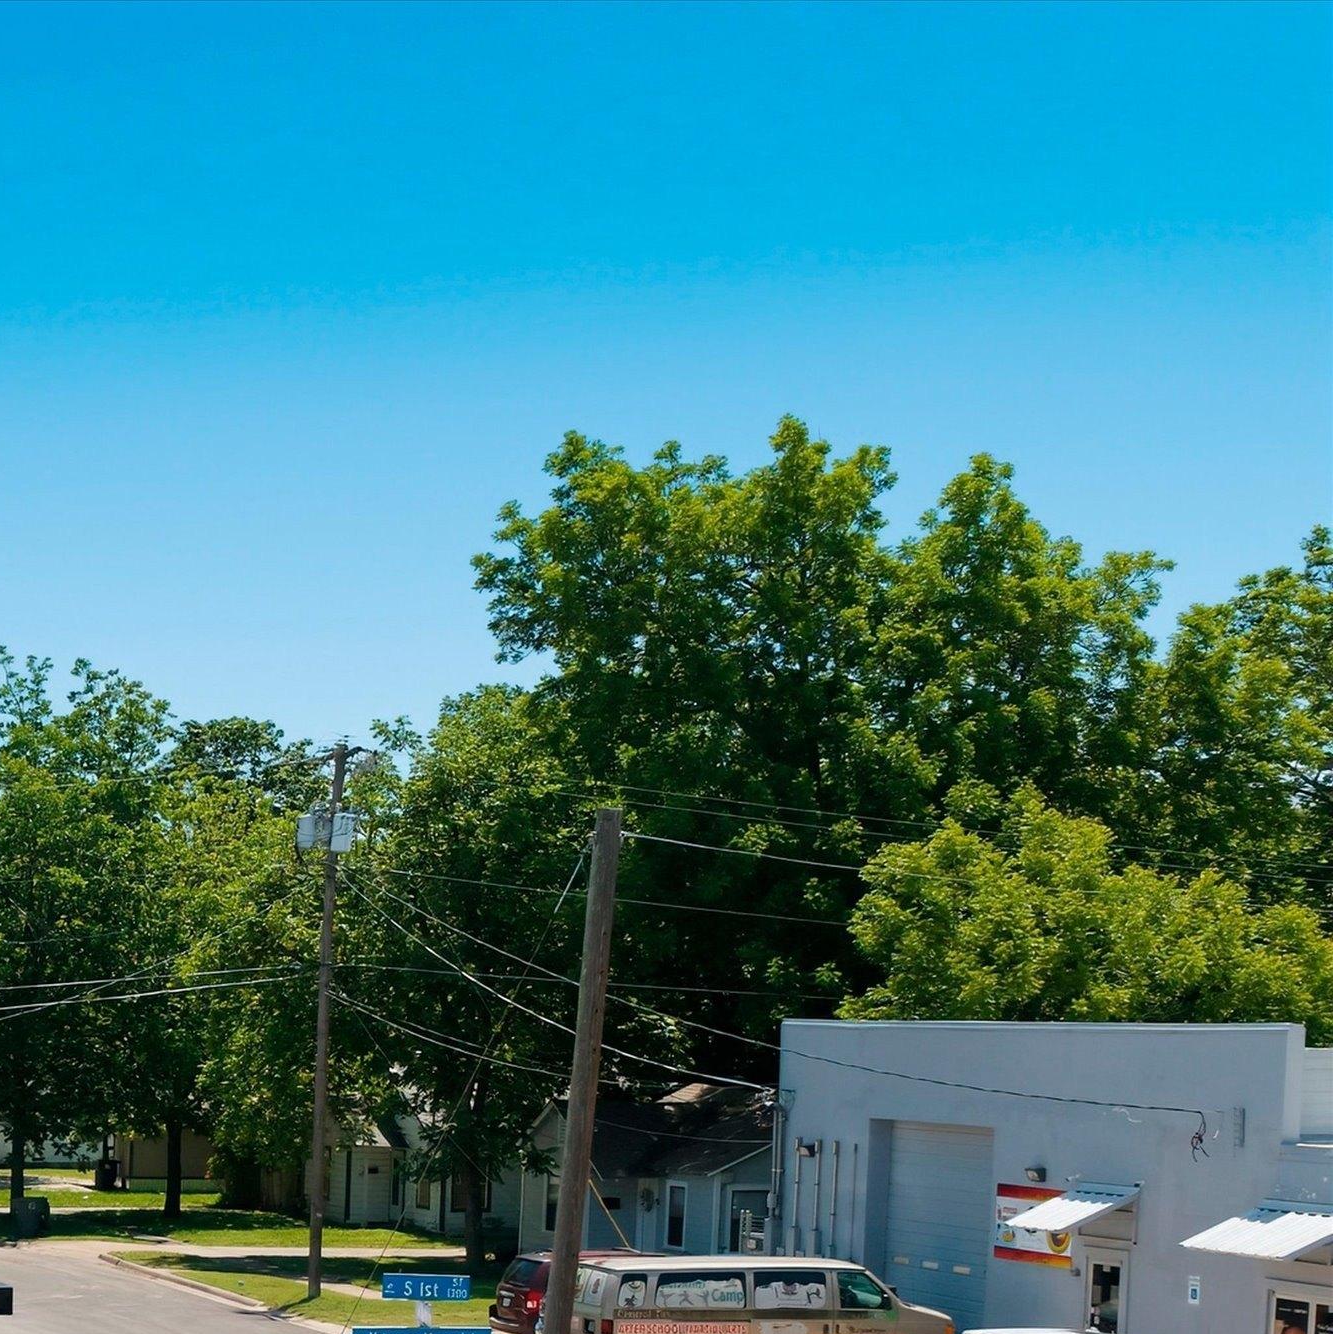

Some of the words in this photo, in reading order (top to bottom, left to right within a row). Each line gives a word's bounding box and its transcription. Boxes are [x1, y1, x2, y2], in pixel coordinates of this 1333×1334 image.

[403, 1281, 413, 1297] S
[420, 1282, 439, 1298] 1st
[711, 1288, 745, 1304] Camp
